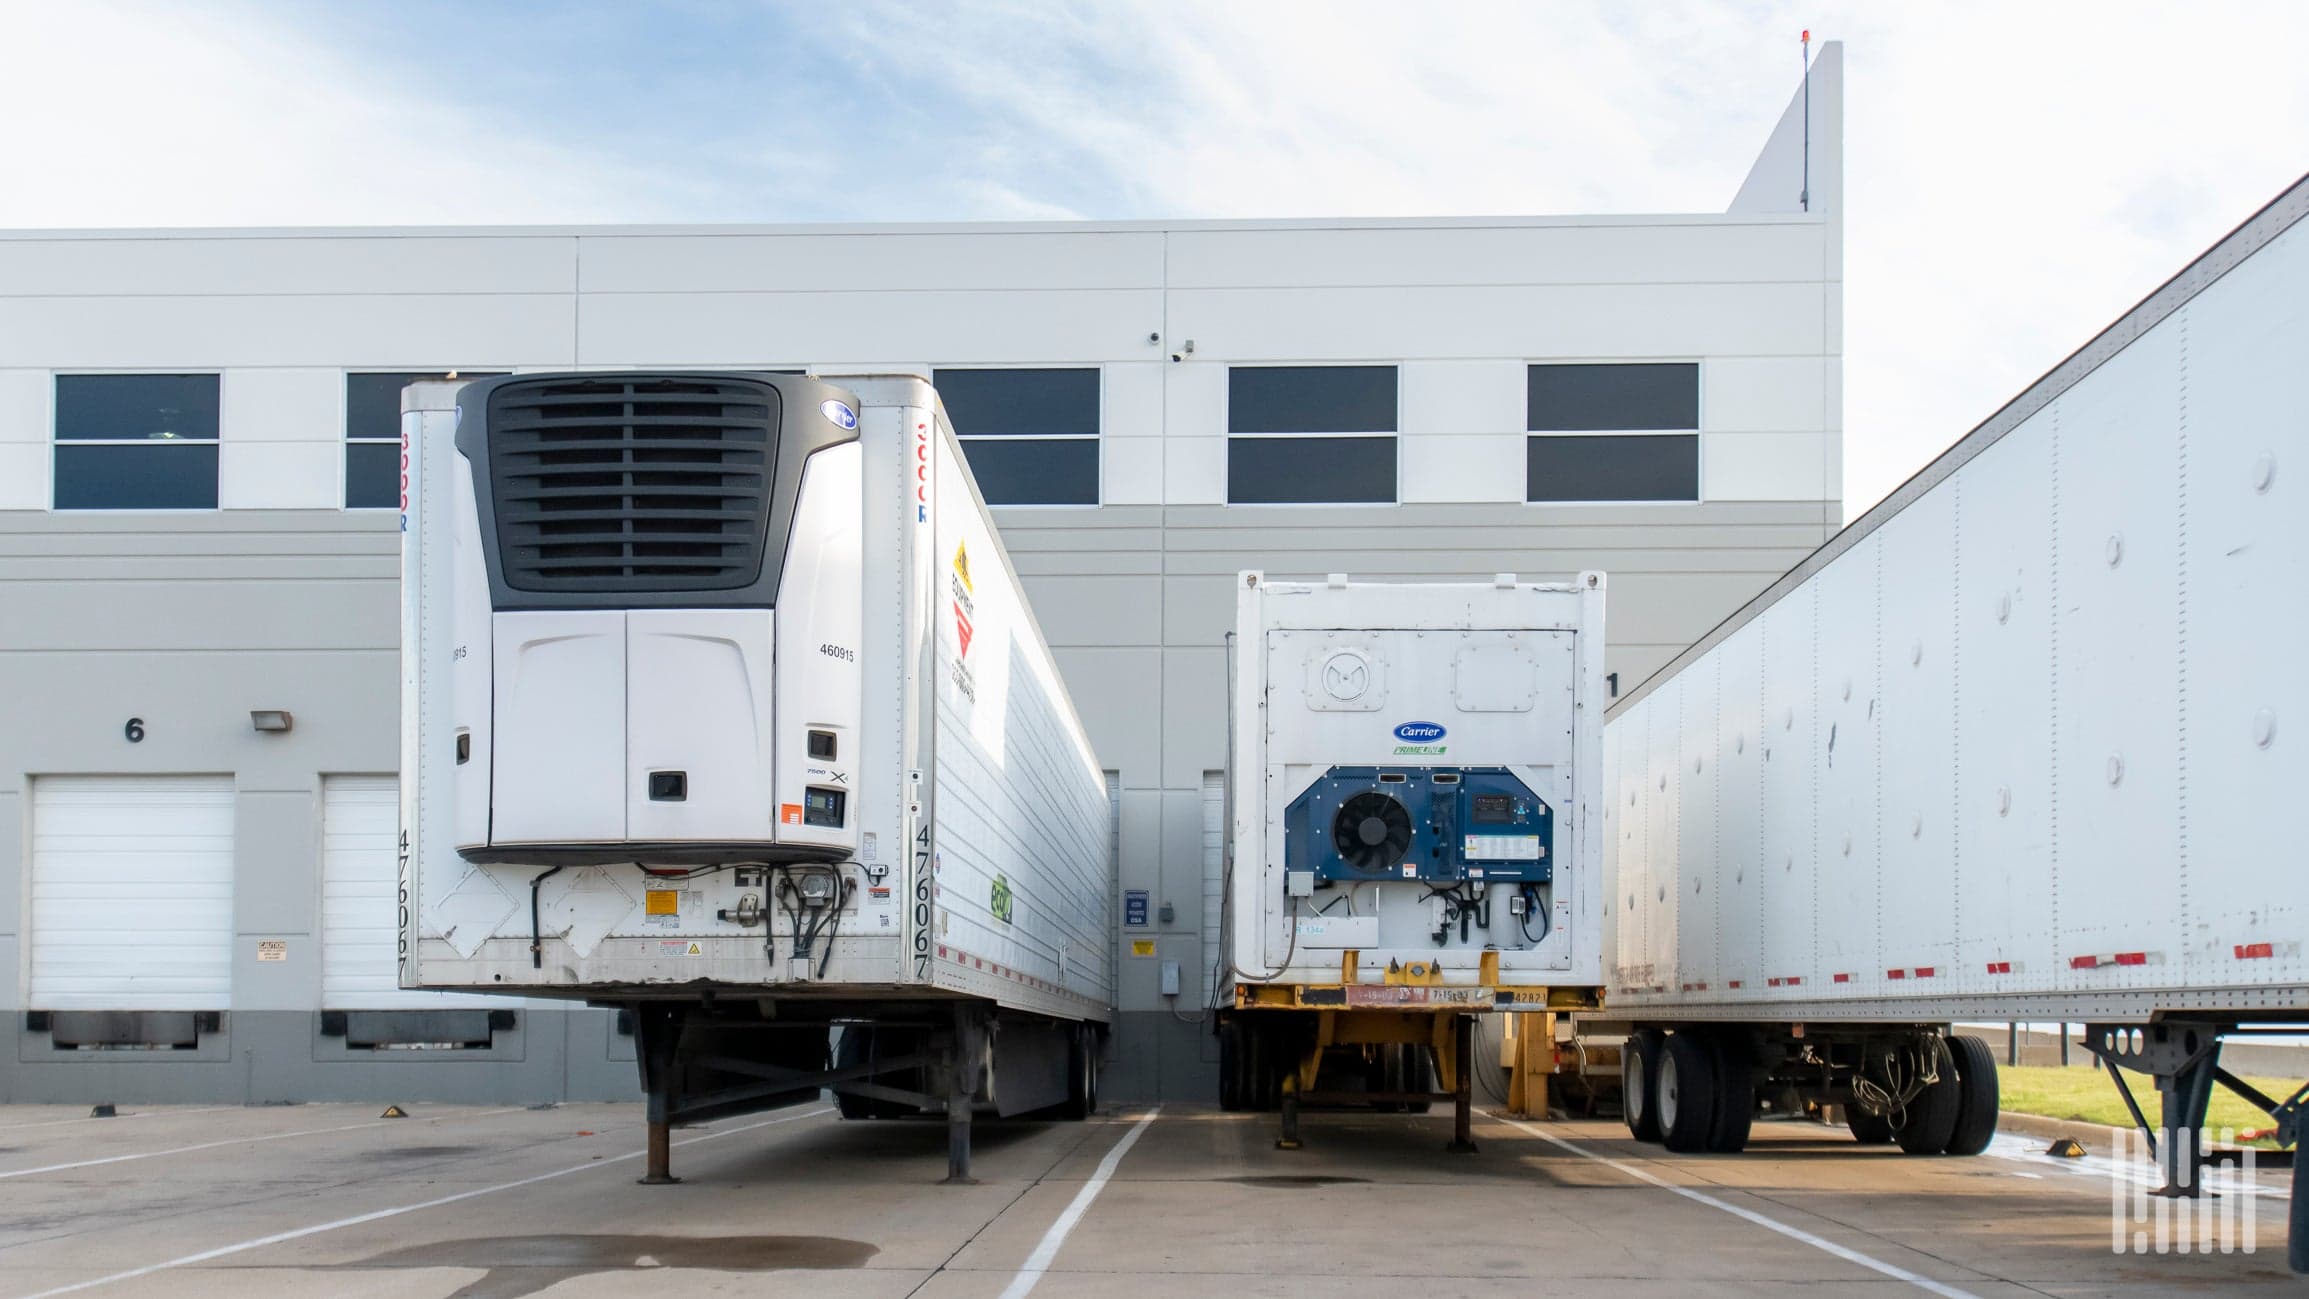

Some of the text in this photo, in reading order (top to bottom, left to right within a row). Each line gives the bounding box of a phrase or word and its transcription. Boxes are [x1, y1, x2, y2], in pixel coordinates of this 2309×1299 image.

[820, 643, 854, 663] 460915
[1606, 672, 1618, 698] 1
[125, 717, 145, 743] 6
[1400, 726, 1440, 737] Carrier
[915, 825, 929, 979] 476067
